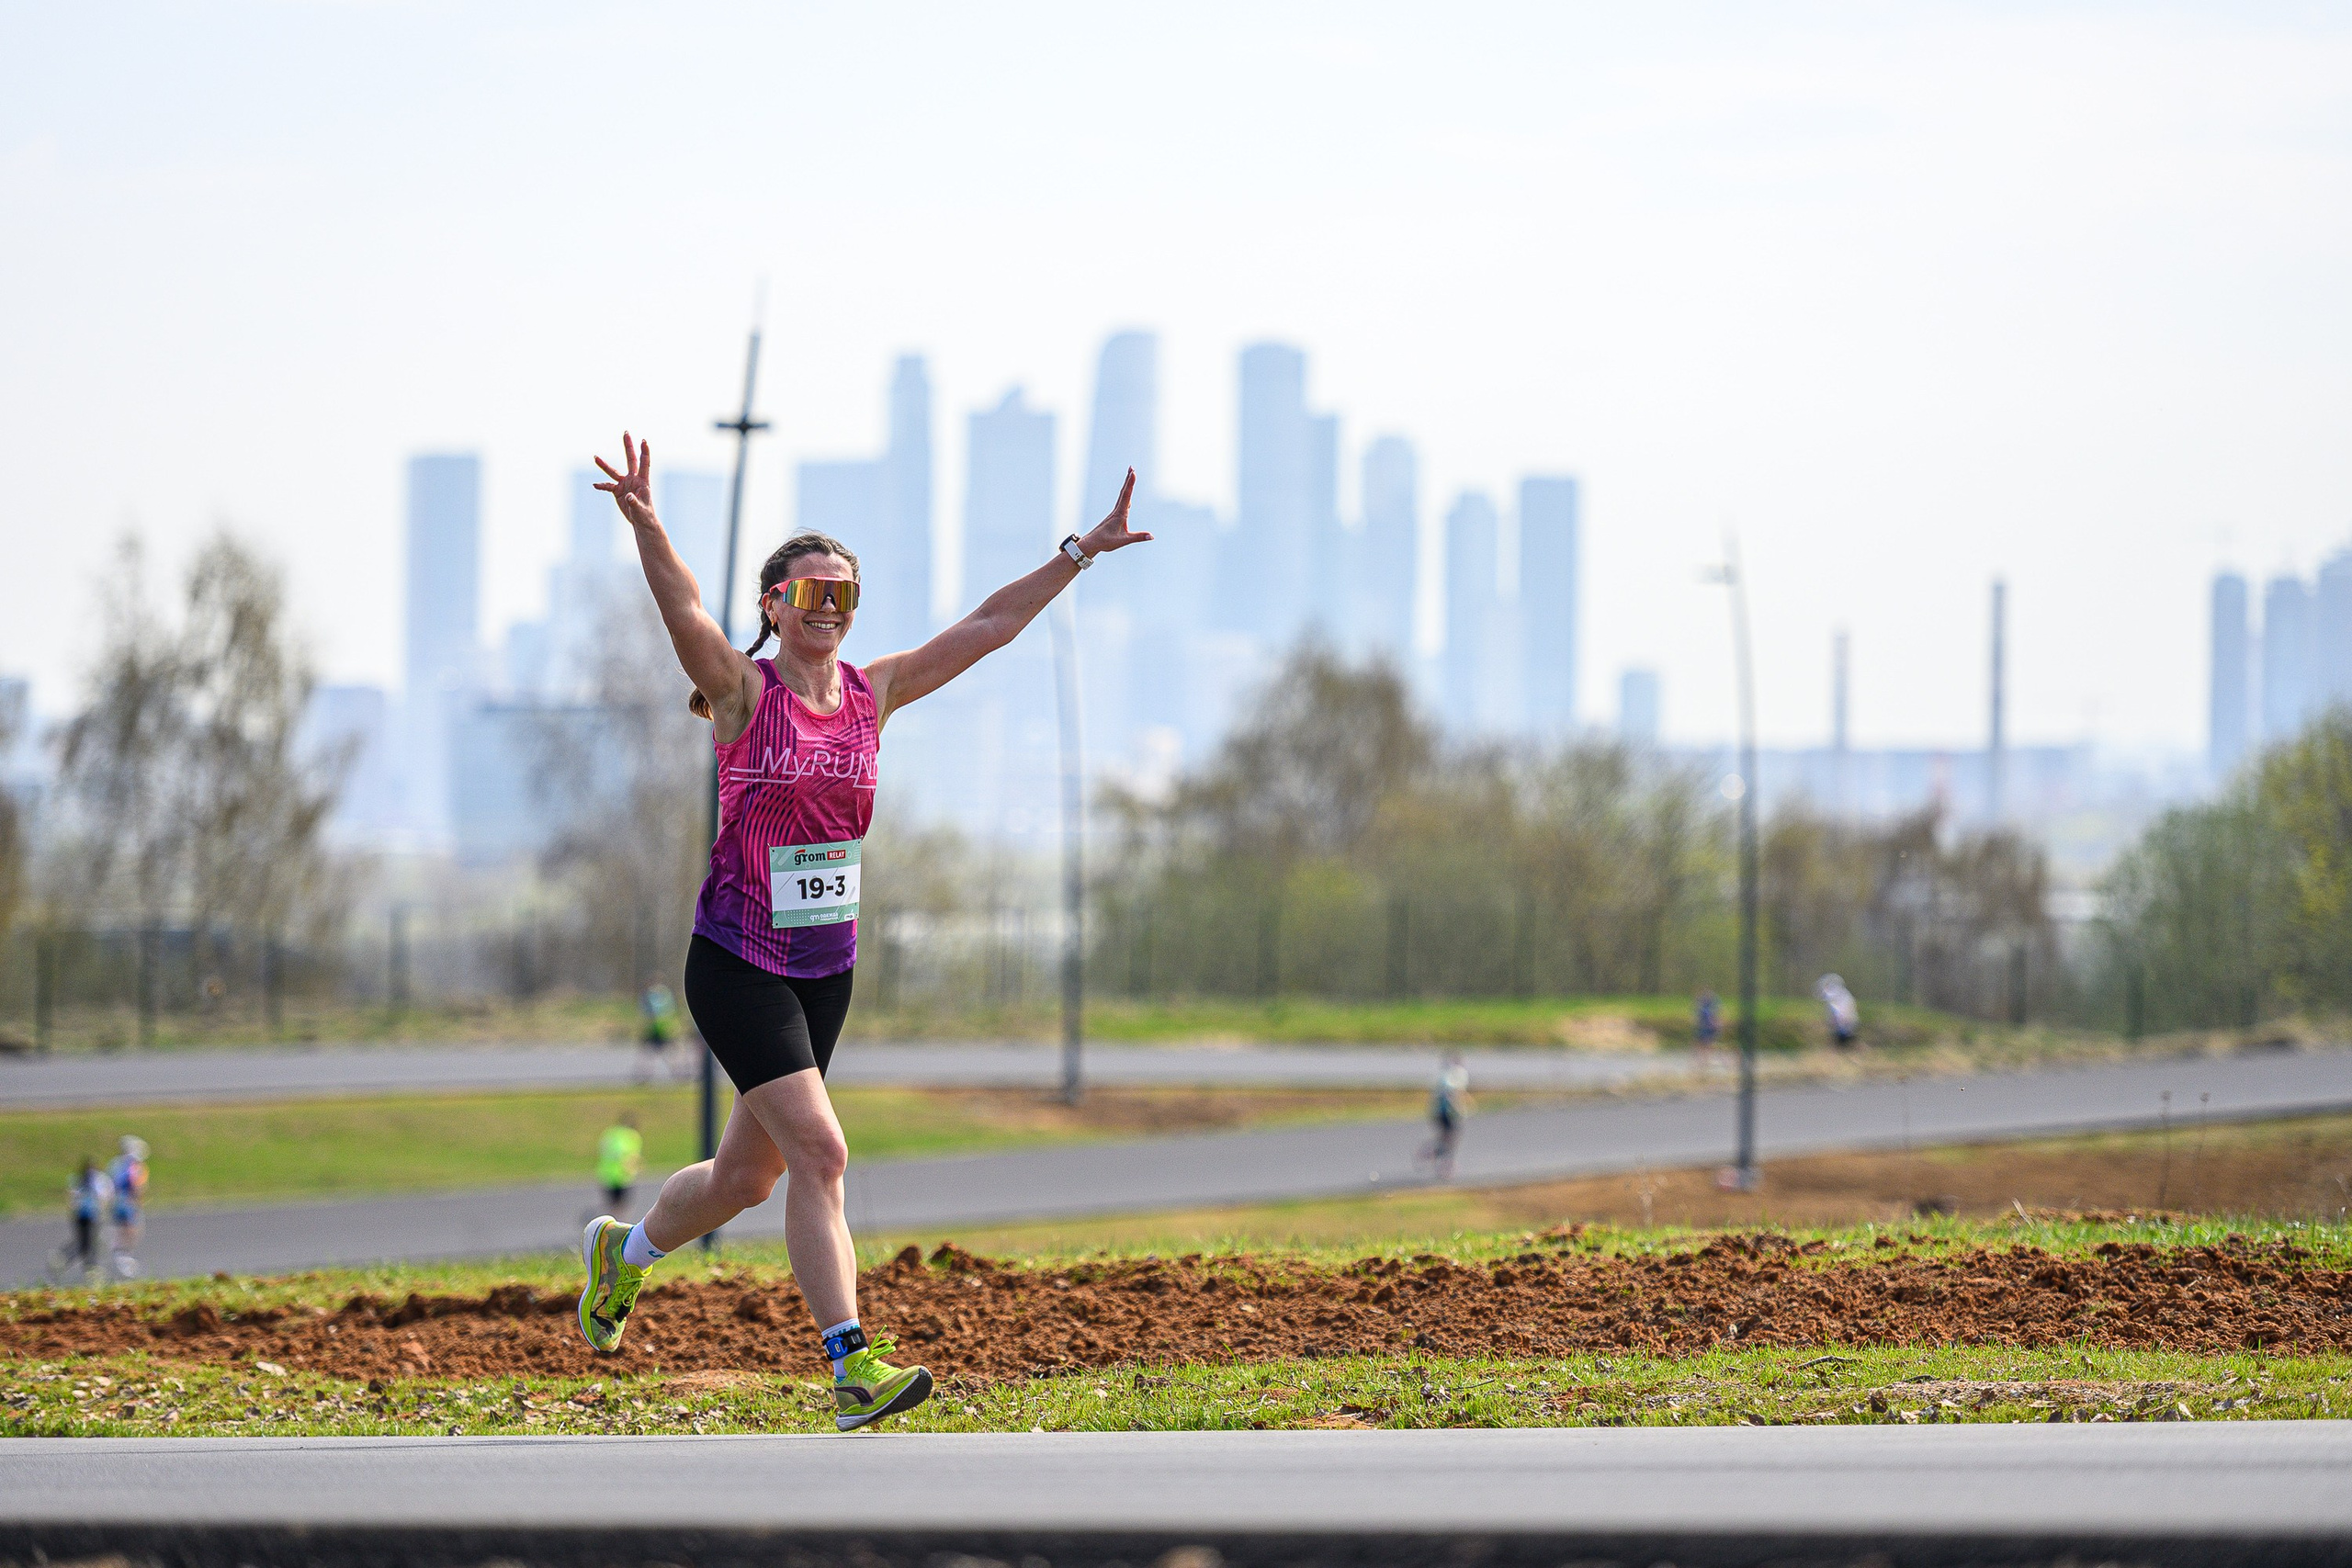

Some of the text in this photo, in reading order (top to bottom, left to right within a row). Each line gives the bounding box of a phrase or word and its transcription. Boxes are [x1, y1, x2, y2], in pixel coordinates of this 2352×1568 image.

[795, 851, 845, 865] grom RELAY
[797, 875, 845, 900] 19-3
